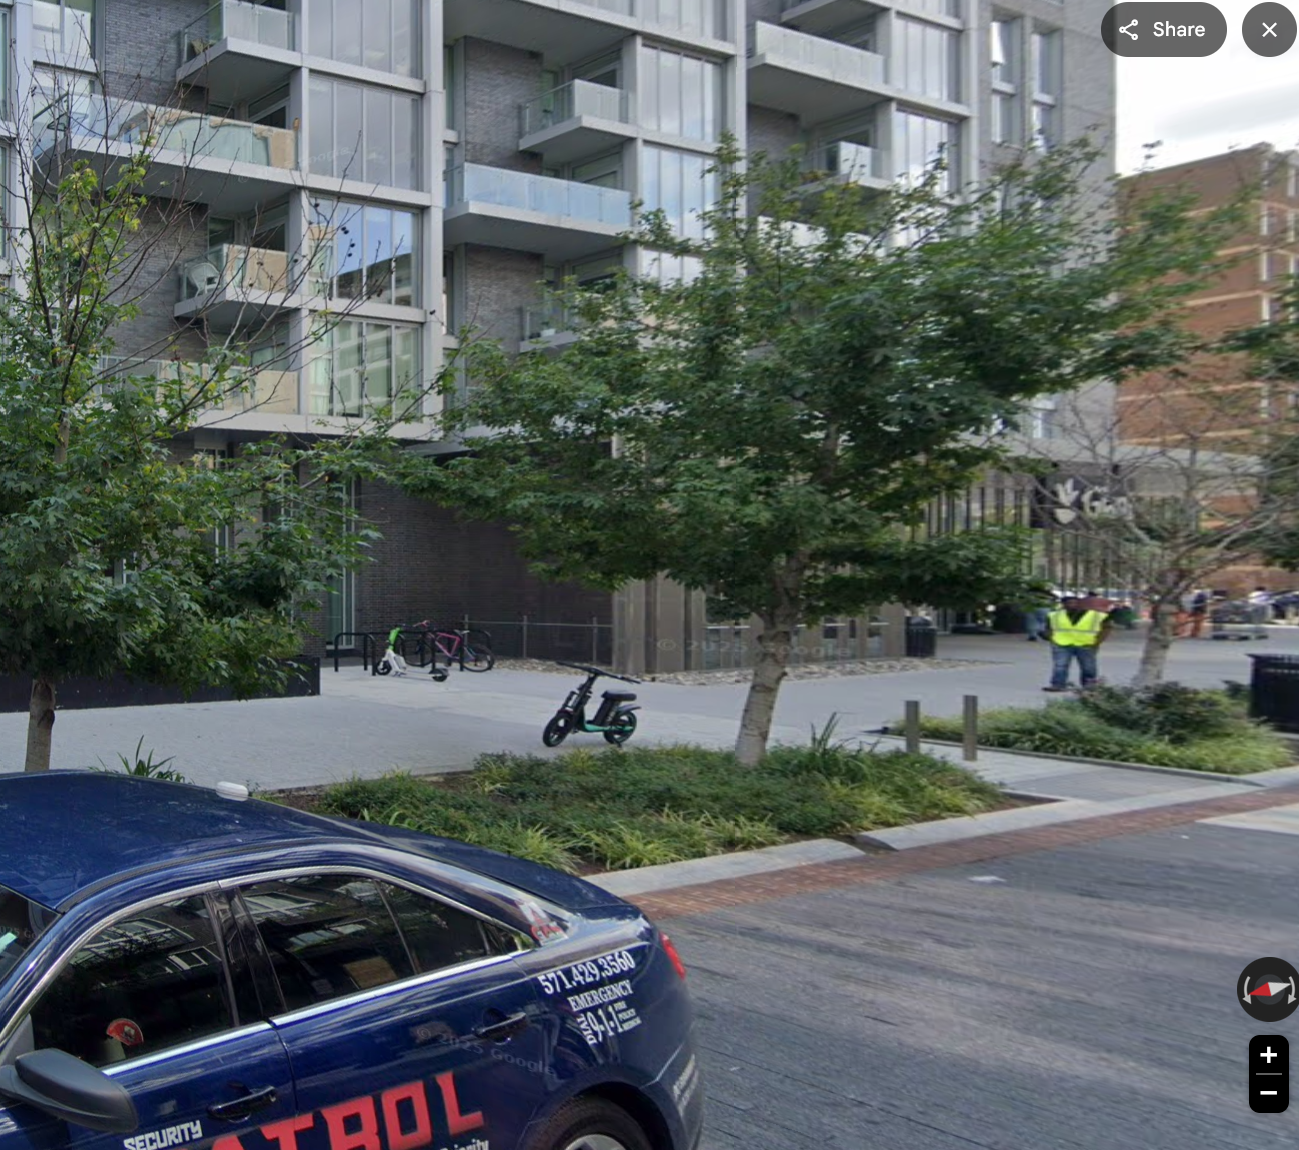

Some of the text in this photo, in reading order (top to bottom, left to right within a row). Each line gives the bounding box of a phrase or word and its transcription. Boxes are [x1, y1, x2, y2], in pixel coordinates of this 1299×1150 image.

[538, 951, 636, 995] 571.429.3560
[567, 980, 634, 1011] EMERGENCY
[576, 1013, 598, 1045] DIAL
[124, 1120, 203, 1150] SECURITY
